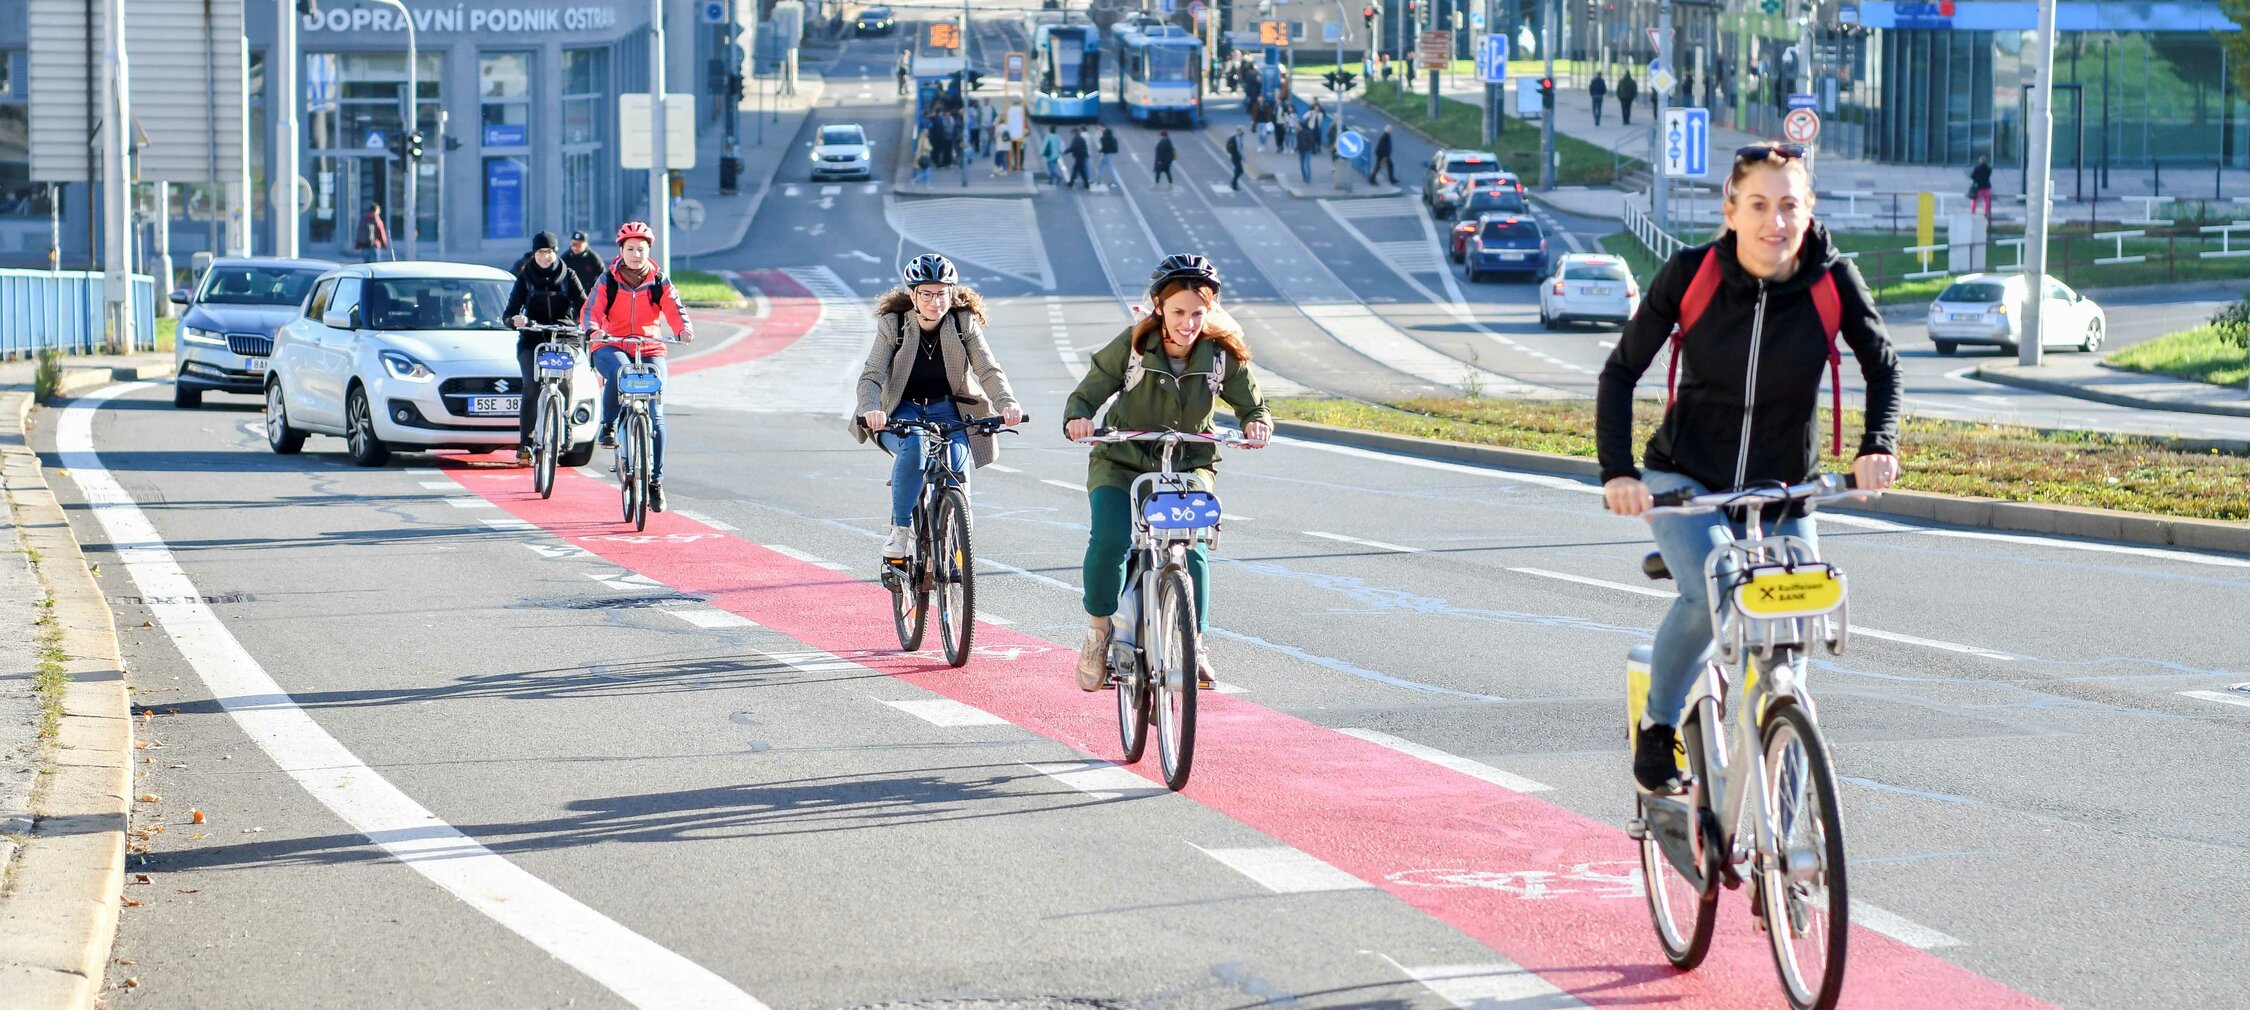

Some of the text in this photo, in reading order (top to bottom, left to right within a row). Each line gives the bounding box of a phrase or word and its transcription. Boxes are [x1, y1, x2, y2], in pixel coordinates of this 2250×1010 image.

[303, 3, 464, 32] DOPRAVNÍ
[470, 8, 560, 31] PODNIK
[477, 398, 521, 411] 5SE 38
